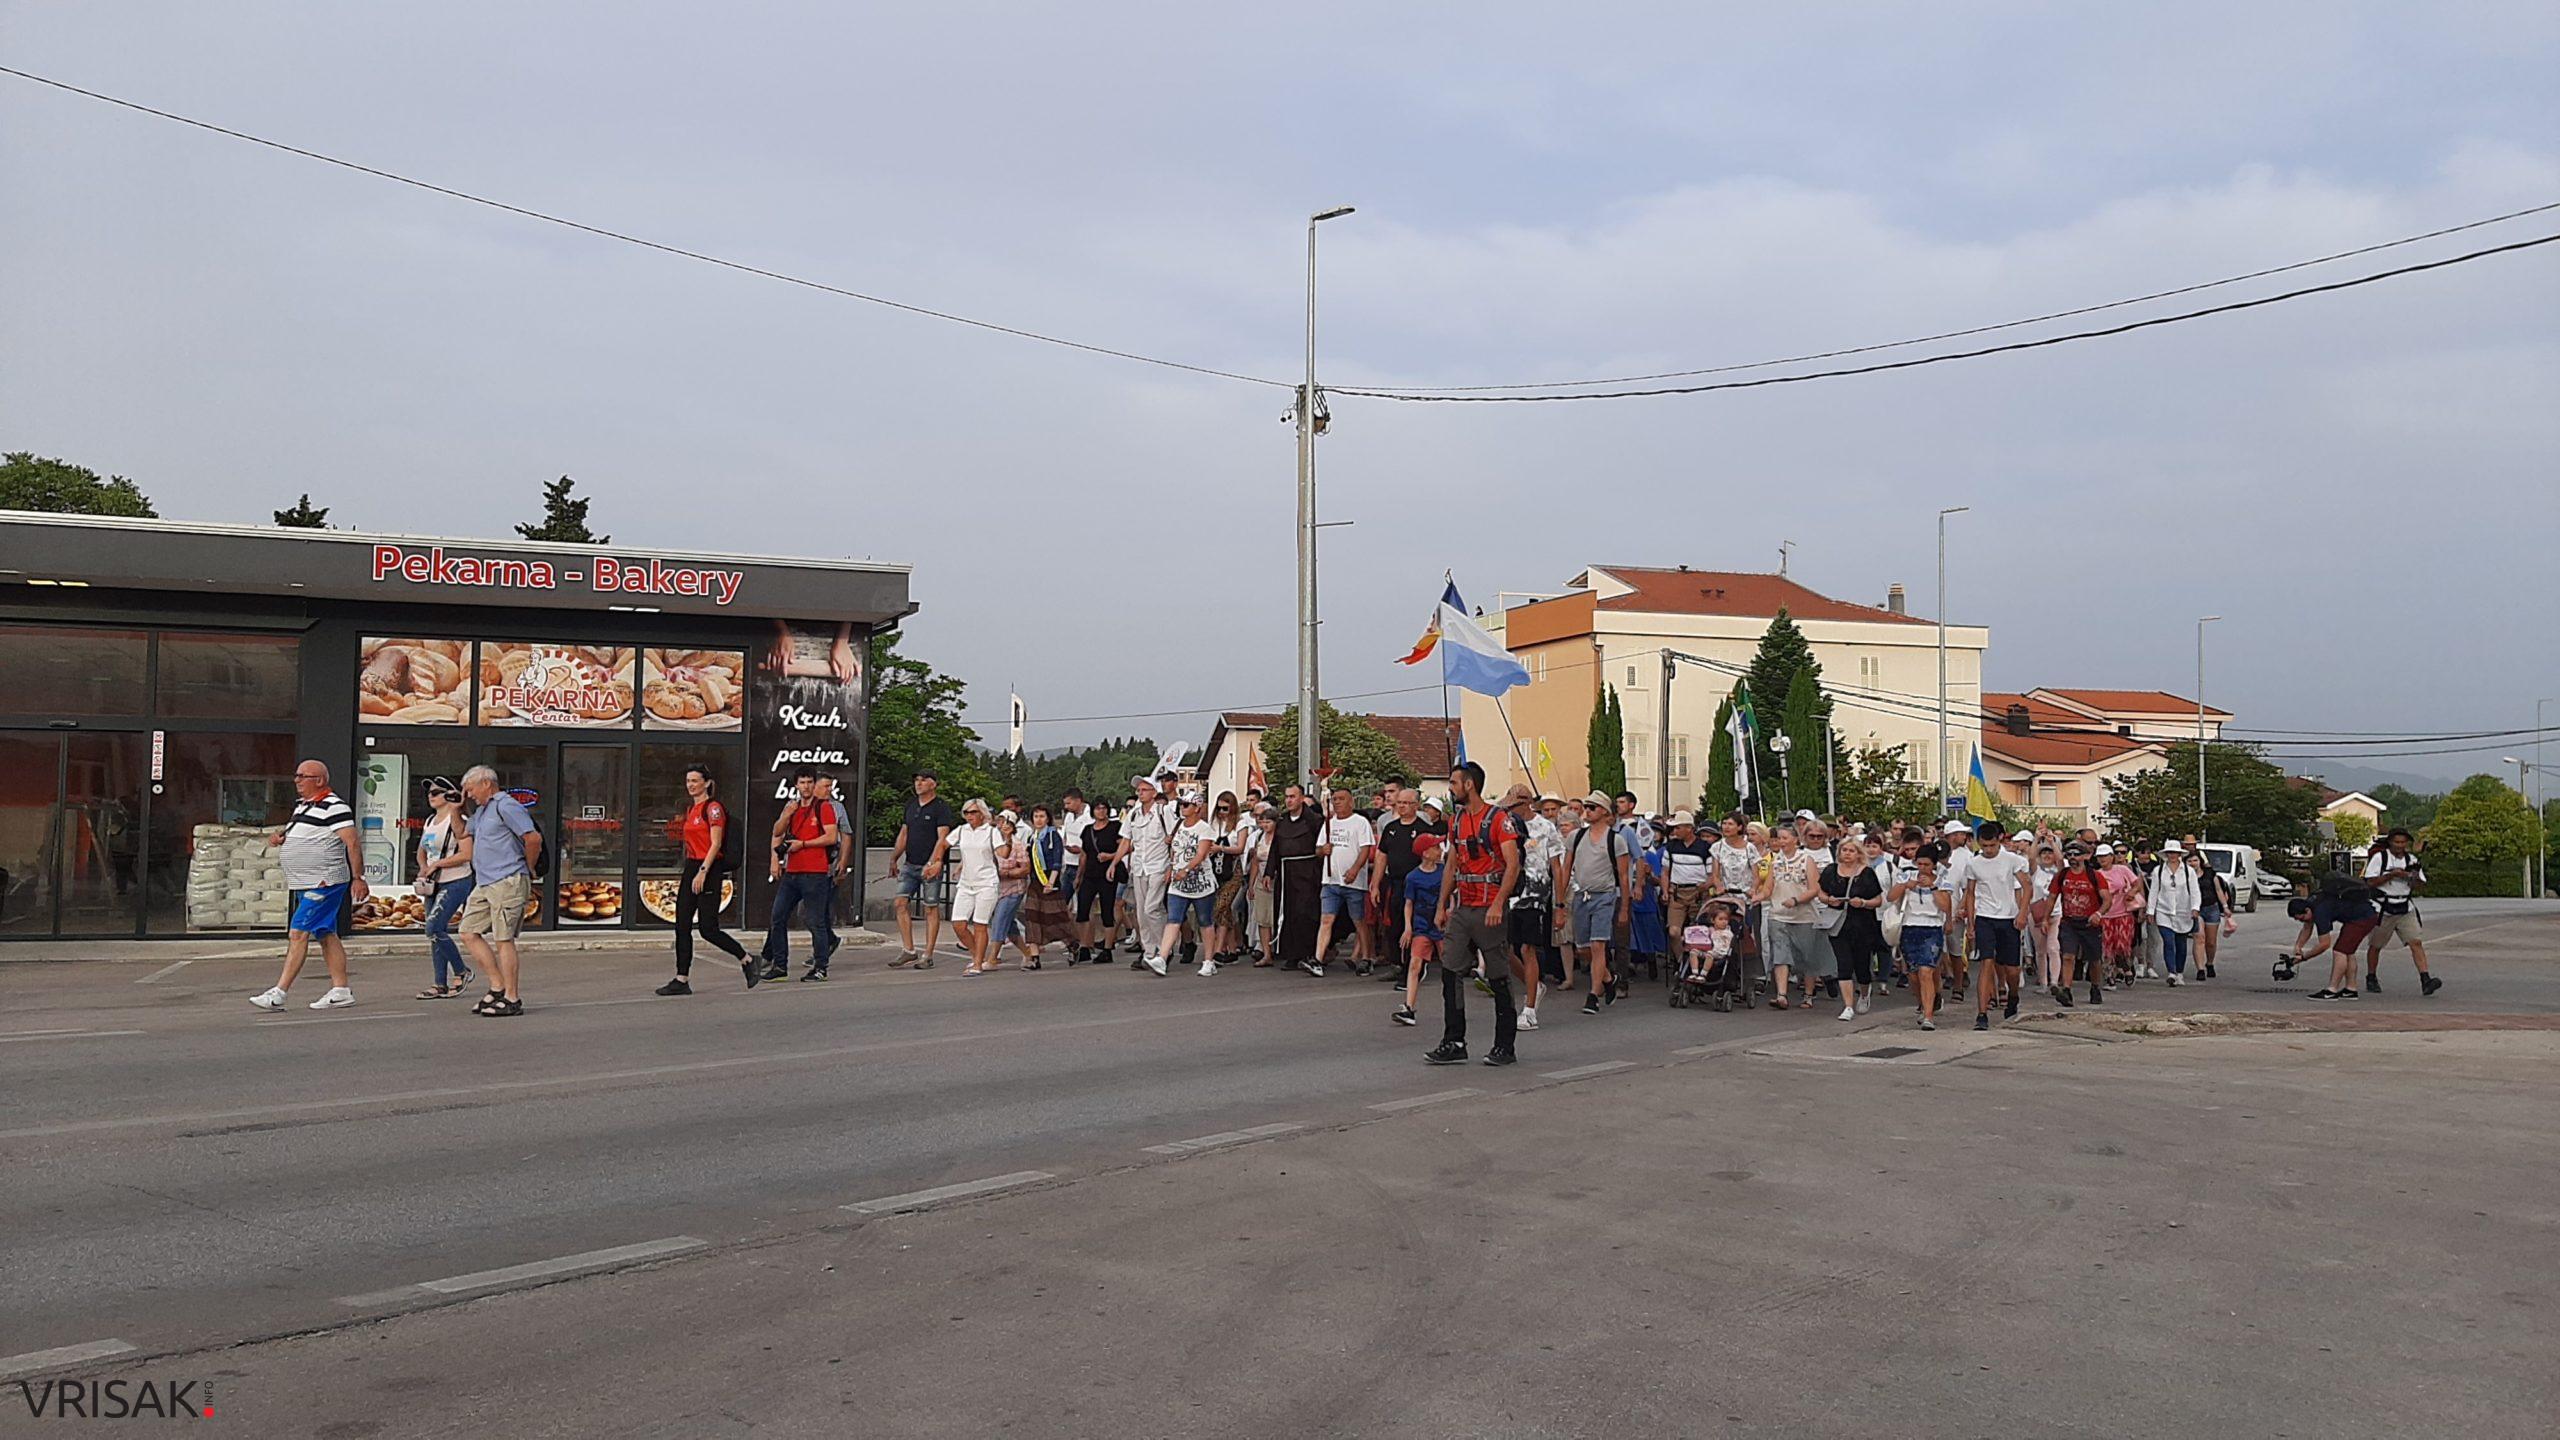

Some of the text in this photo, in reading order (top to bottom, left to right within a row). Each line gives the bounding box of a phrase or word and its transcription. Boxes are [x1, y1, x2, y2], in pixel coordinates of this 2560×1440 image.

[373, 545, 555, 588] Pekarna
[593, 557, 743, 605] Bakery
[491, 687, 620, 711] PEKARNA
[530, 709, 580, 725] Centar
[779, 704, 848, 730] Kruh,
[771, 746, 850, 772] peciva,
[775, 778, 845, 802] buk,
